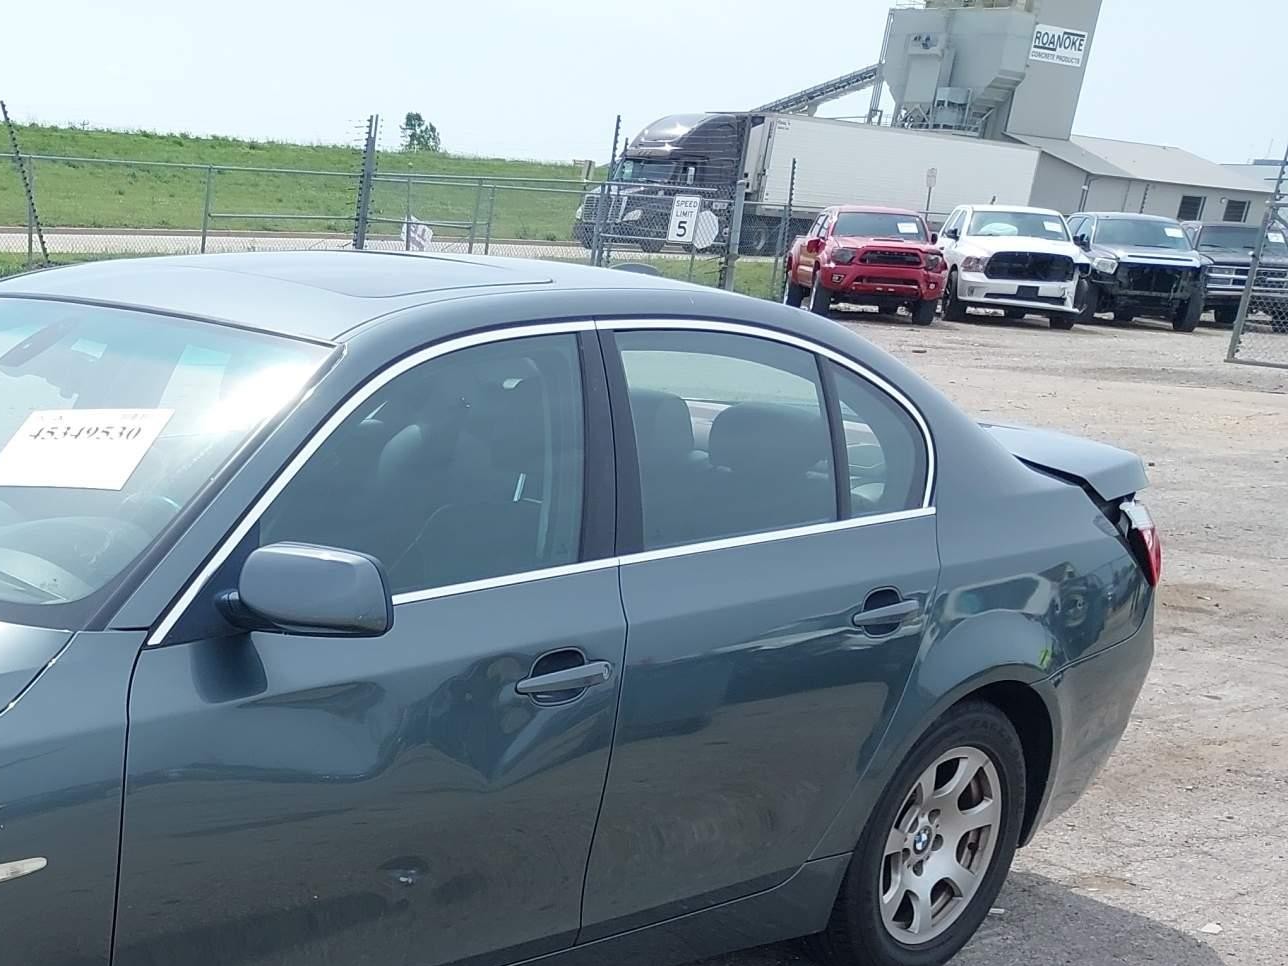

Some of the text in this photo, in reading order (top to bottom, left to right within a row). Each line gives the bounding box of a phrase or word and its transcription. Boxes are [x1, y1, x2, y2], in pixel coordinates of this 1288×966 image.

[1033, 30, 1085, 52] ROANOKE
[675, 200, 698, 208] SPEED
[675, 209, 695, 218] LIMIT
[675, 220, 688, 238] 5
[28, 425, 142, 441] 45349530
